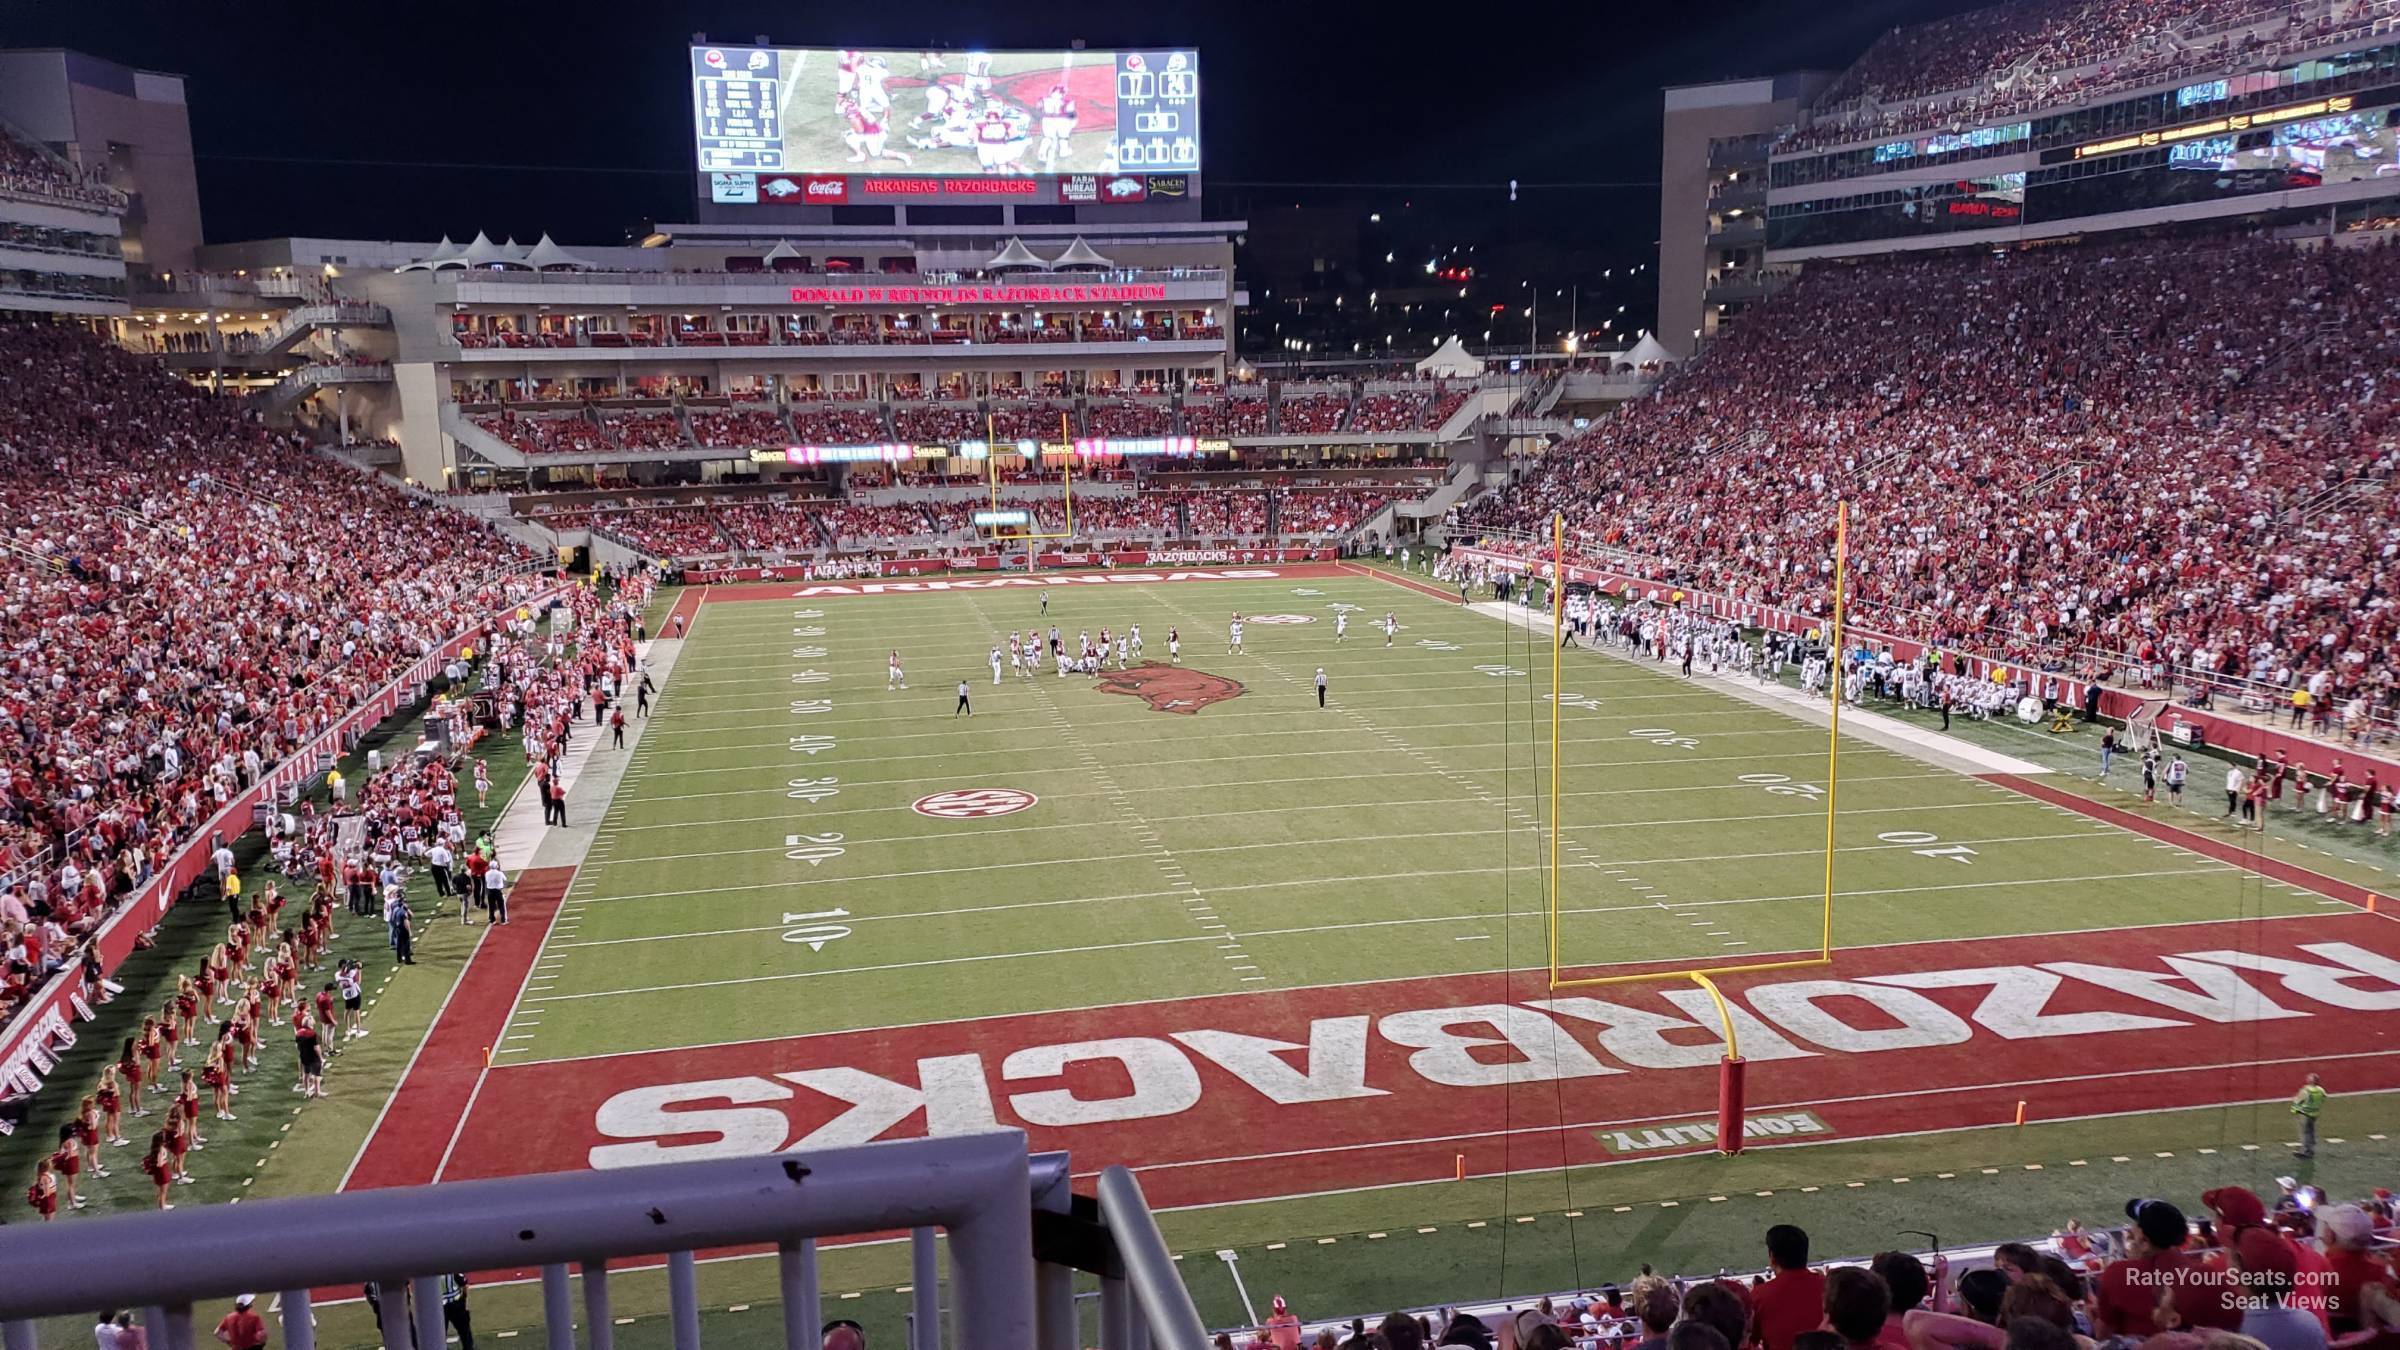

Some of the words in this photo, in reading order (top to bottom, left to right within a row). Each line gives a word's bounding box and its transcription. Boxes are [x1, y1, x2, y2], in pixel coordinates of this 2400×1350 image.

[864, 179, 938, 193] ARKANSAS
[944, 180, 1036, 193] RAZORBACKS
[1062, 184, 1097, 193] BUREAU
[1071, 175, 1095, 185] FARM
[791, 287, 863, 302] DONALD
[887, 287, 978, 302] REYNOLDS
[982, 287, 1084, 301] RAZORBACK
[1090, 285, 1165, 300] STADIUM
[792, 570, 1280, 597] ARKANSAS
[1737, 773, 1828, 796] 20
[785, 832, 845, 859] 20
[1876, 831, 1980, 860] 10
[782, 908, 851, 942] 10
